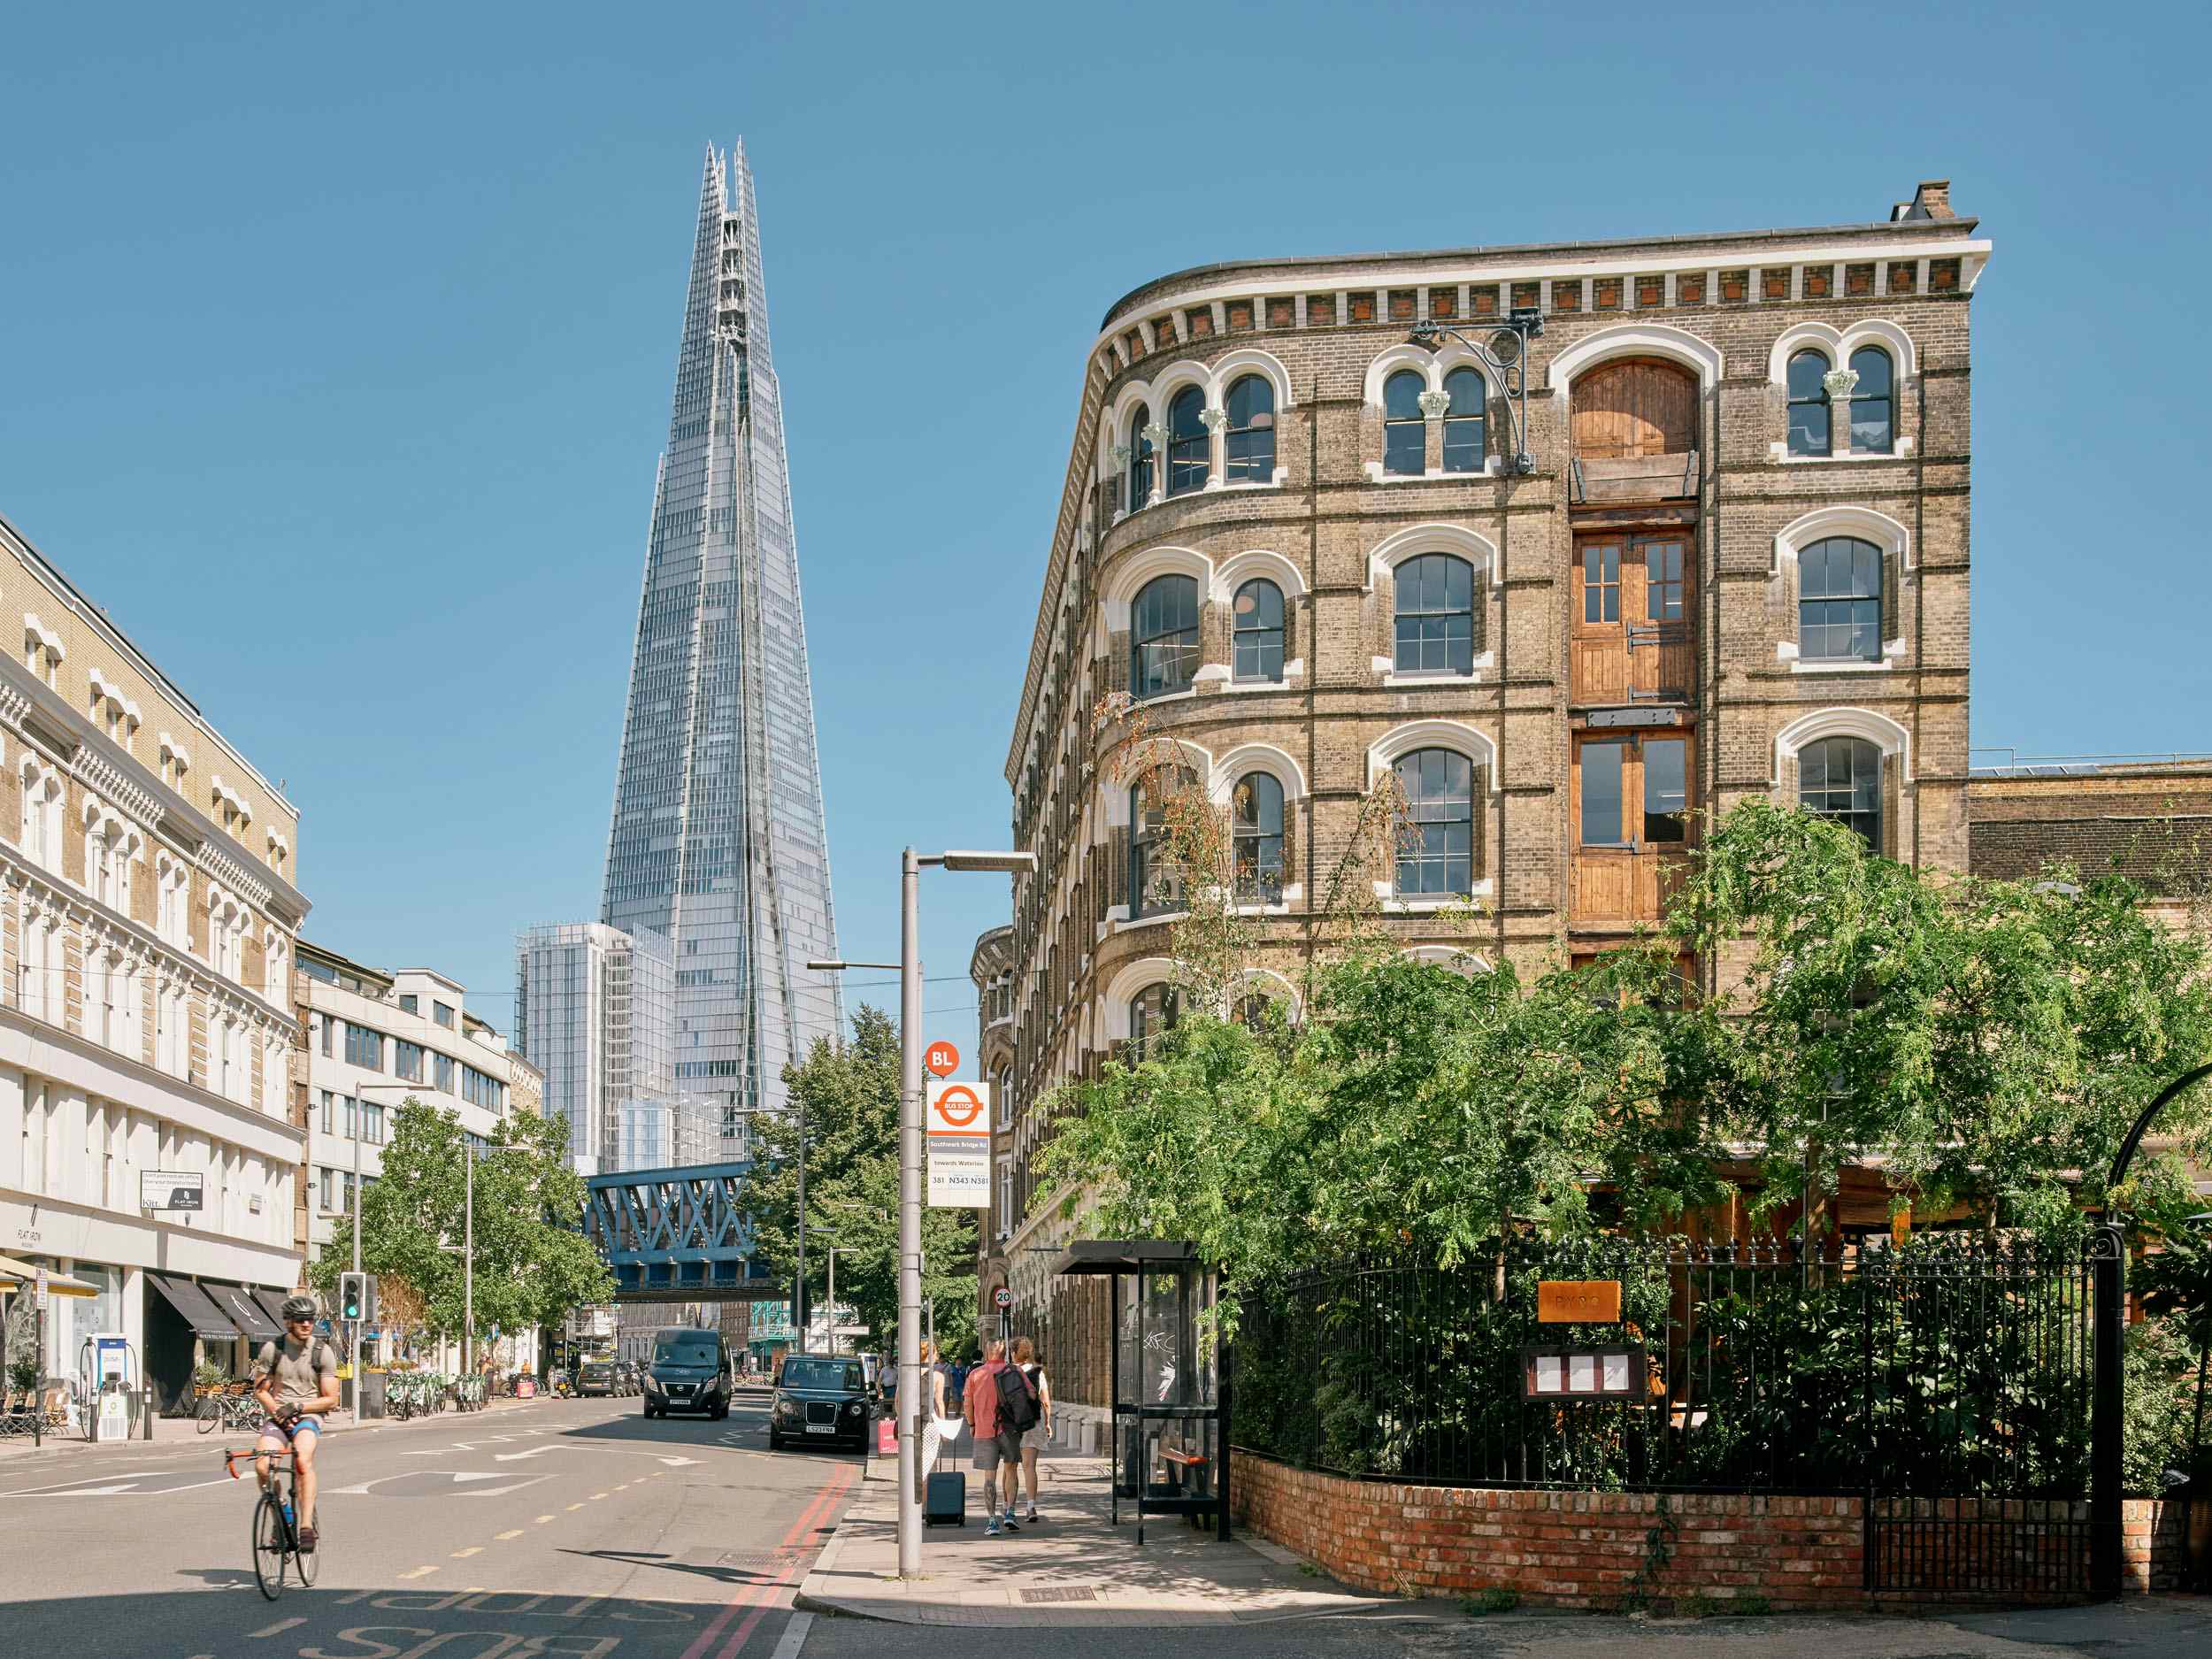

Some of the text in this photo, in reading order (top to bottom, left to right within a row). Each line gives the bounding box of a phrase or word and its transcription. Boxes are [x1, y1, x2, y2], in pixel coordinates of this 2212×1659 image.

[932, 1051, 953, 1066] BL
[997, 1293, 1010, 1302] 20
[298, 1626, 621, 1659] BUS
